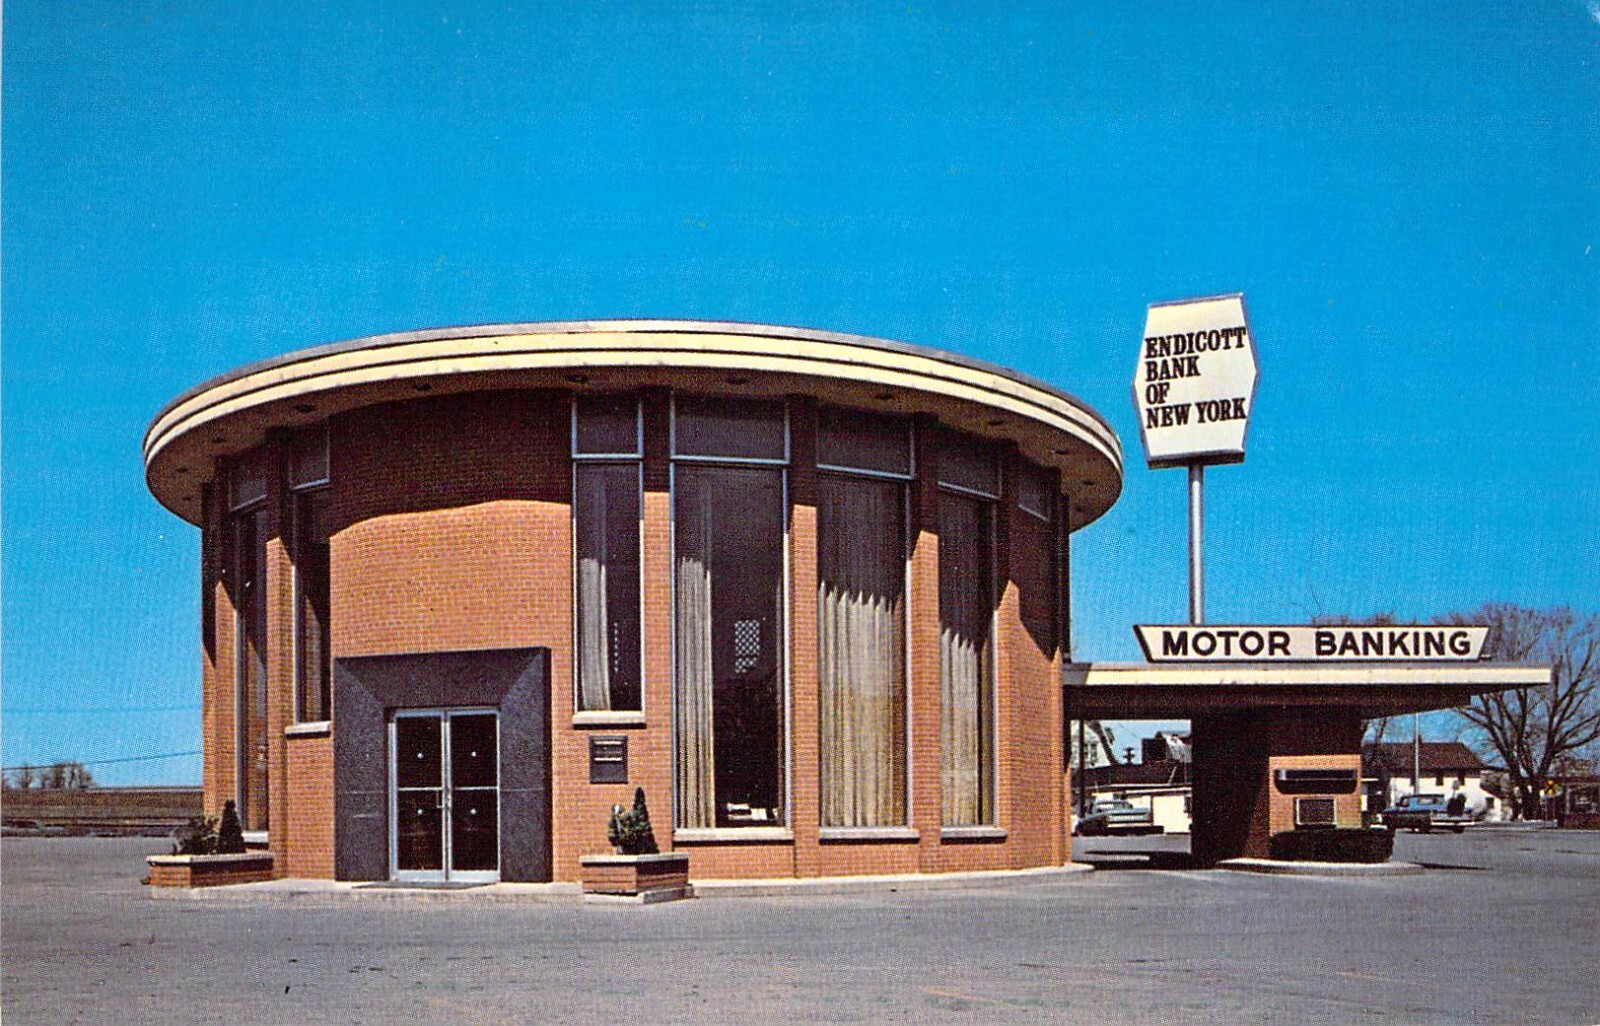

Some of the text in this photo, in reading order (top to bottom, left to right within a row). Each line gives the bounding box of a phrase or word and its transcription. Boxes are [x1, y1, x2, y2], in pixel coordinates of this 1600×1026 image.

[1144, 326, 1246, 358] ENDICOTT
[1145, 355, 1201, 381] BANK
[1145, 382, 1170, 405] OF
[1146, 398, 1247, 429] NEW YORK
[1162, 630, 1471, 657] MOTOR BANKING
